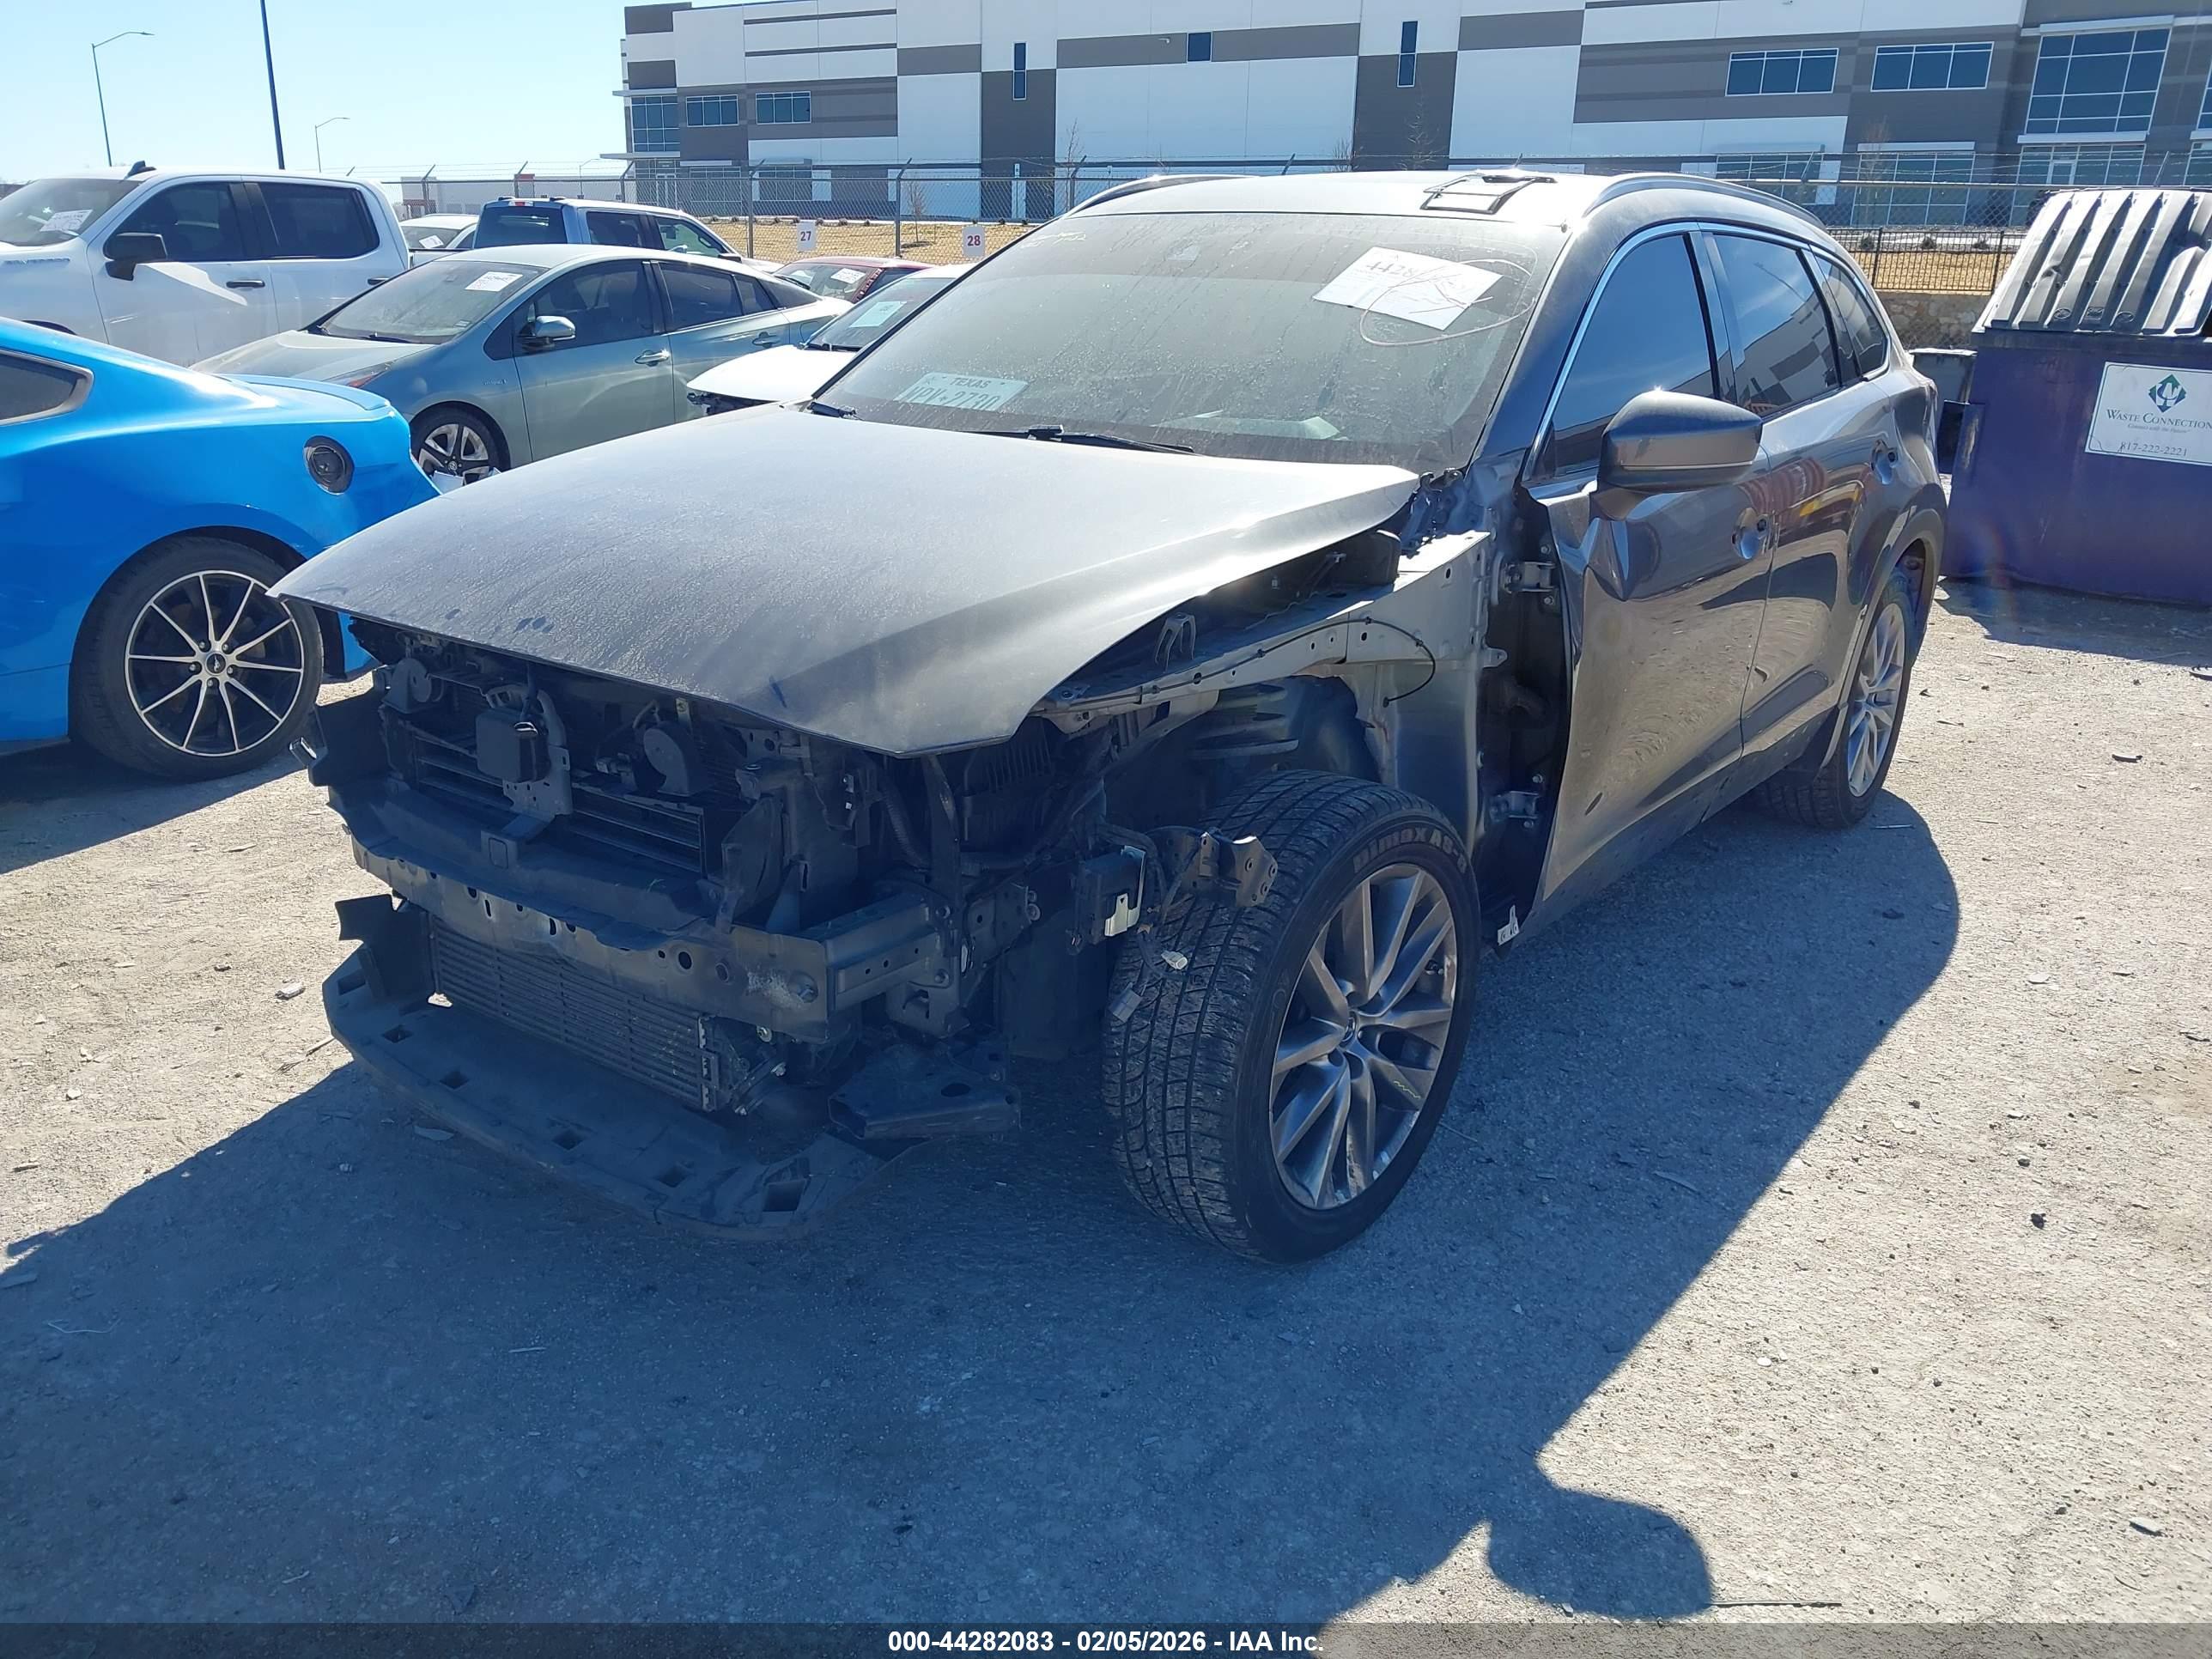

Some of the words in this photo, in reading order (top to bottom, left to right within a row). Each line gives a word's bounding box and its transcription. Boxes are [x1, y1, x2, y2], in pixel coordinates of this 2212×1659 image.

[800, 231, 811, 241] 27
[967, 235, 981, 246] 28
[950, 377, 992, 389] TEXAS
[2120, 441, 2187, 456] 817-222-2221
